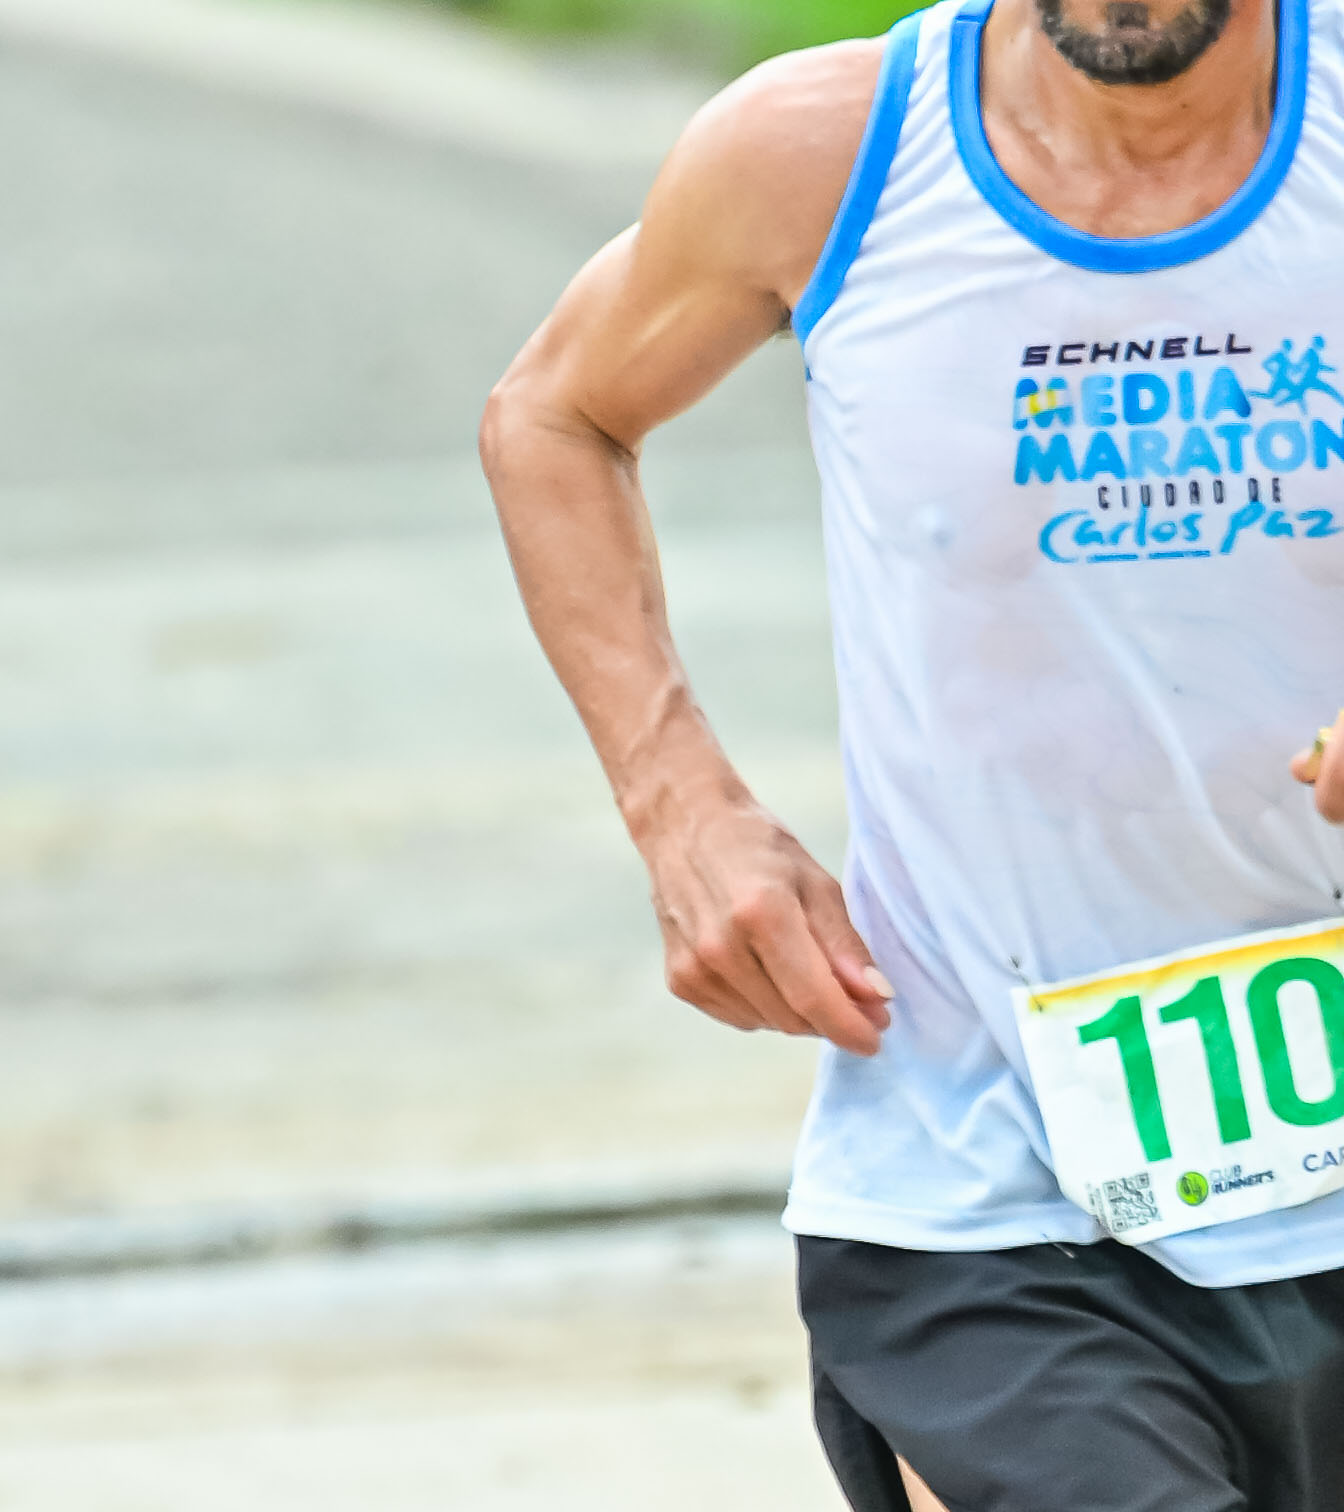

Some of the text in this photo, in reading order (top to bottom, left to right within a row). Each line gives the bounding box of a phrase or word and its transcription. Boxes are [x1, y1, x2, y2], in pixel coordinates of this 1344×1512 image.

[1021, 333, 1252, 368] SCHNELL
[1013, 366, 1252, 431] MEDIA
[1014, 419, 1344, 485] MARATON
[1098, 477, 1281, 510] CIUDAD DE
[1039, 500, 1344, 564] Carlos Paz
[1077, 957, 1344, 1162] 110
